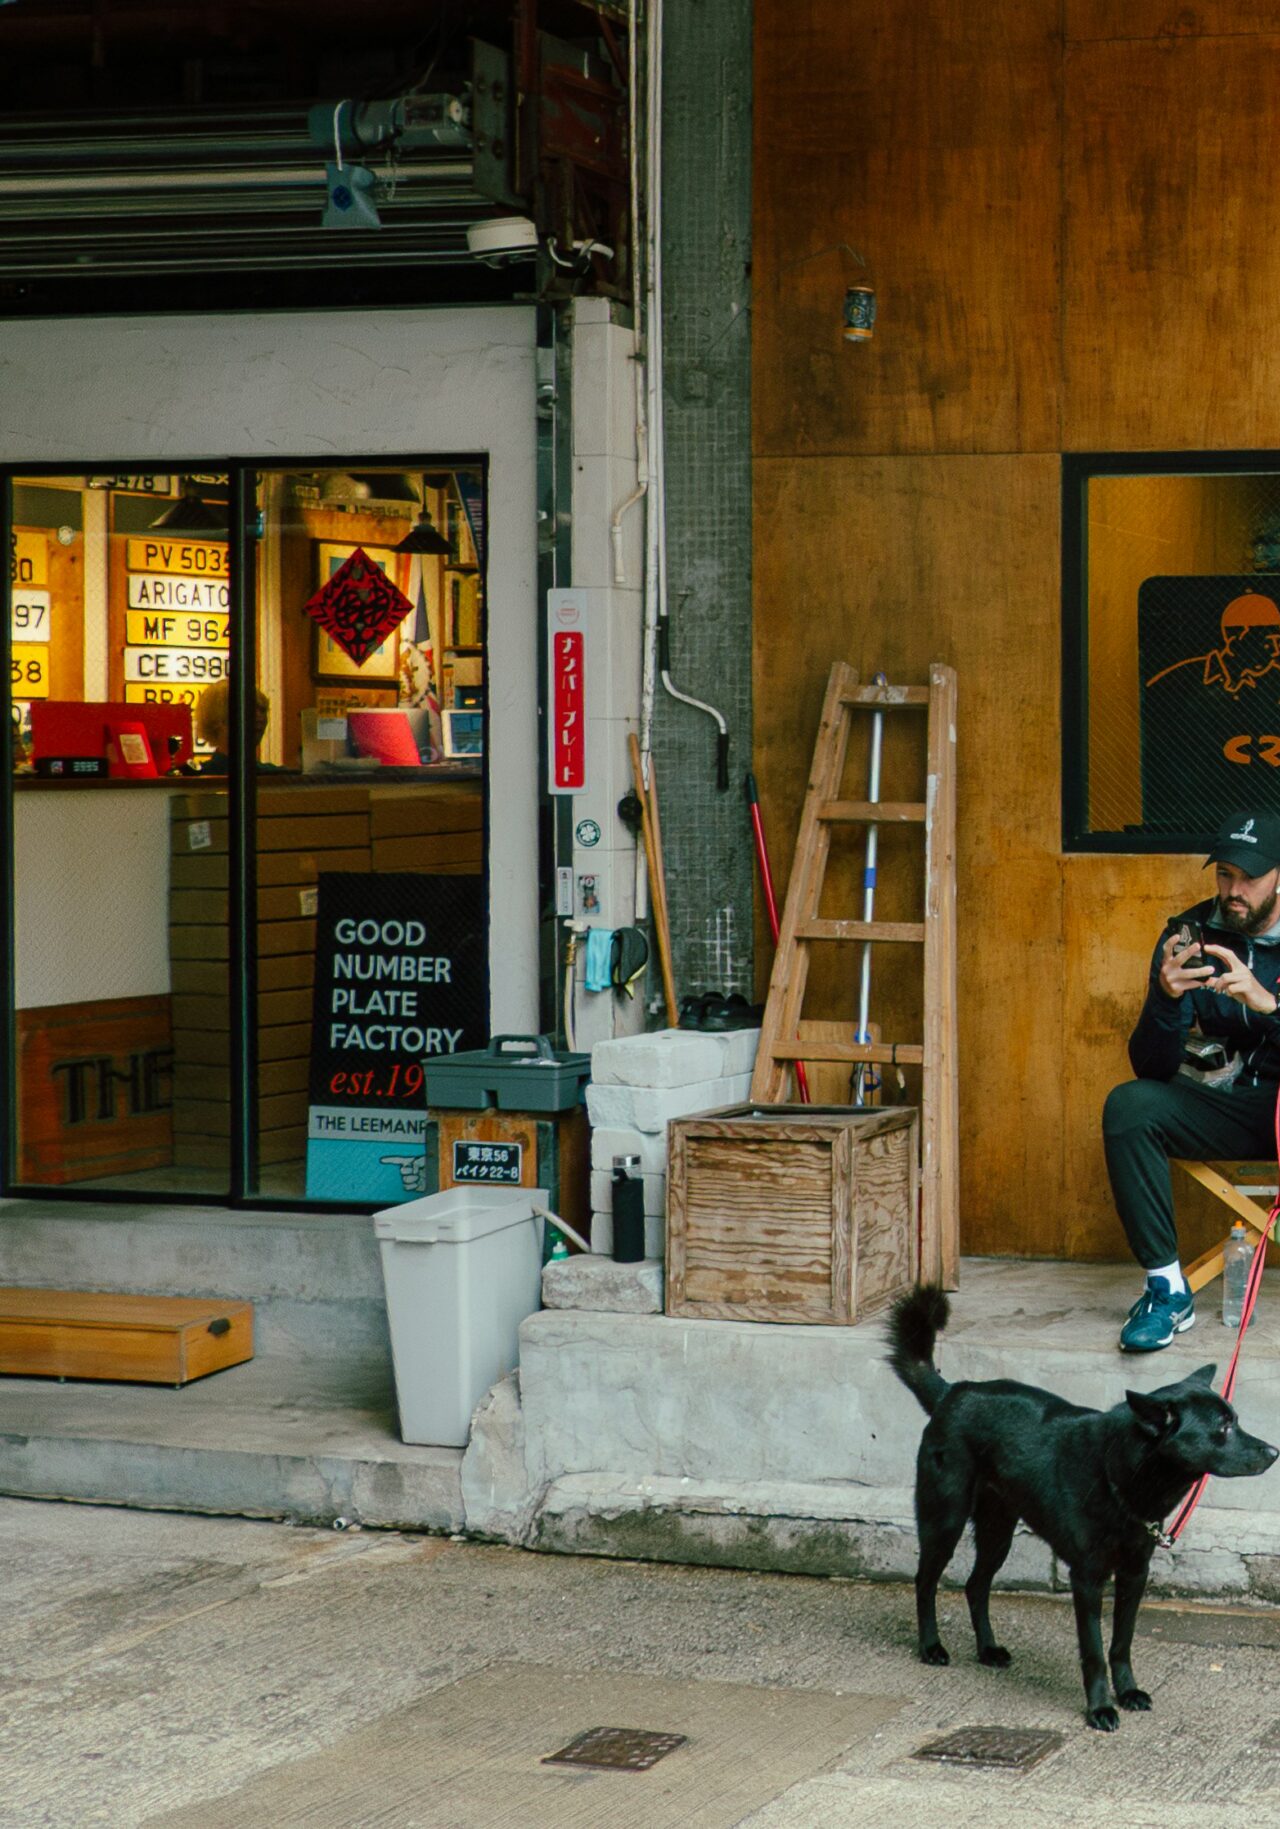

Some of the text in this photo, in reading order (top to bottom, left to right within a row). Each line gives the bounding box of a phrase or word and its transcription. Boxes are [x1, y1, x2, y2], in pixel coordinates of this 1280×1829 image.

[146, 544, 172, 568] PV
[15, 605, 45, 628] 97
[144, 616, 175, 640] MF
[138, 654, 169, 676] CE
[562, 637, 576, 782] ナンバープレート
[335, 919, 426, 946] GOOD
[333, 954, 451, 983] NUMBER
[332, 988, 417, 1017] PLATE
[330, 1023, 463, 1053] FACTORY
[316, 1115, 345, 1131] THE
